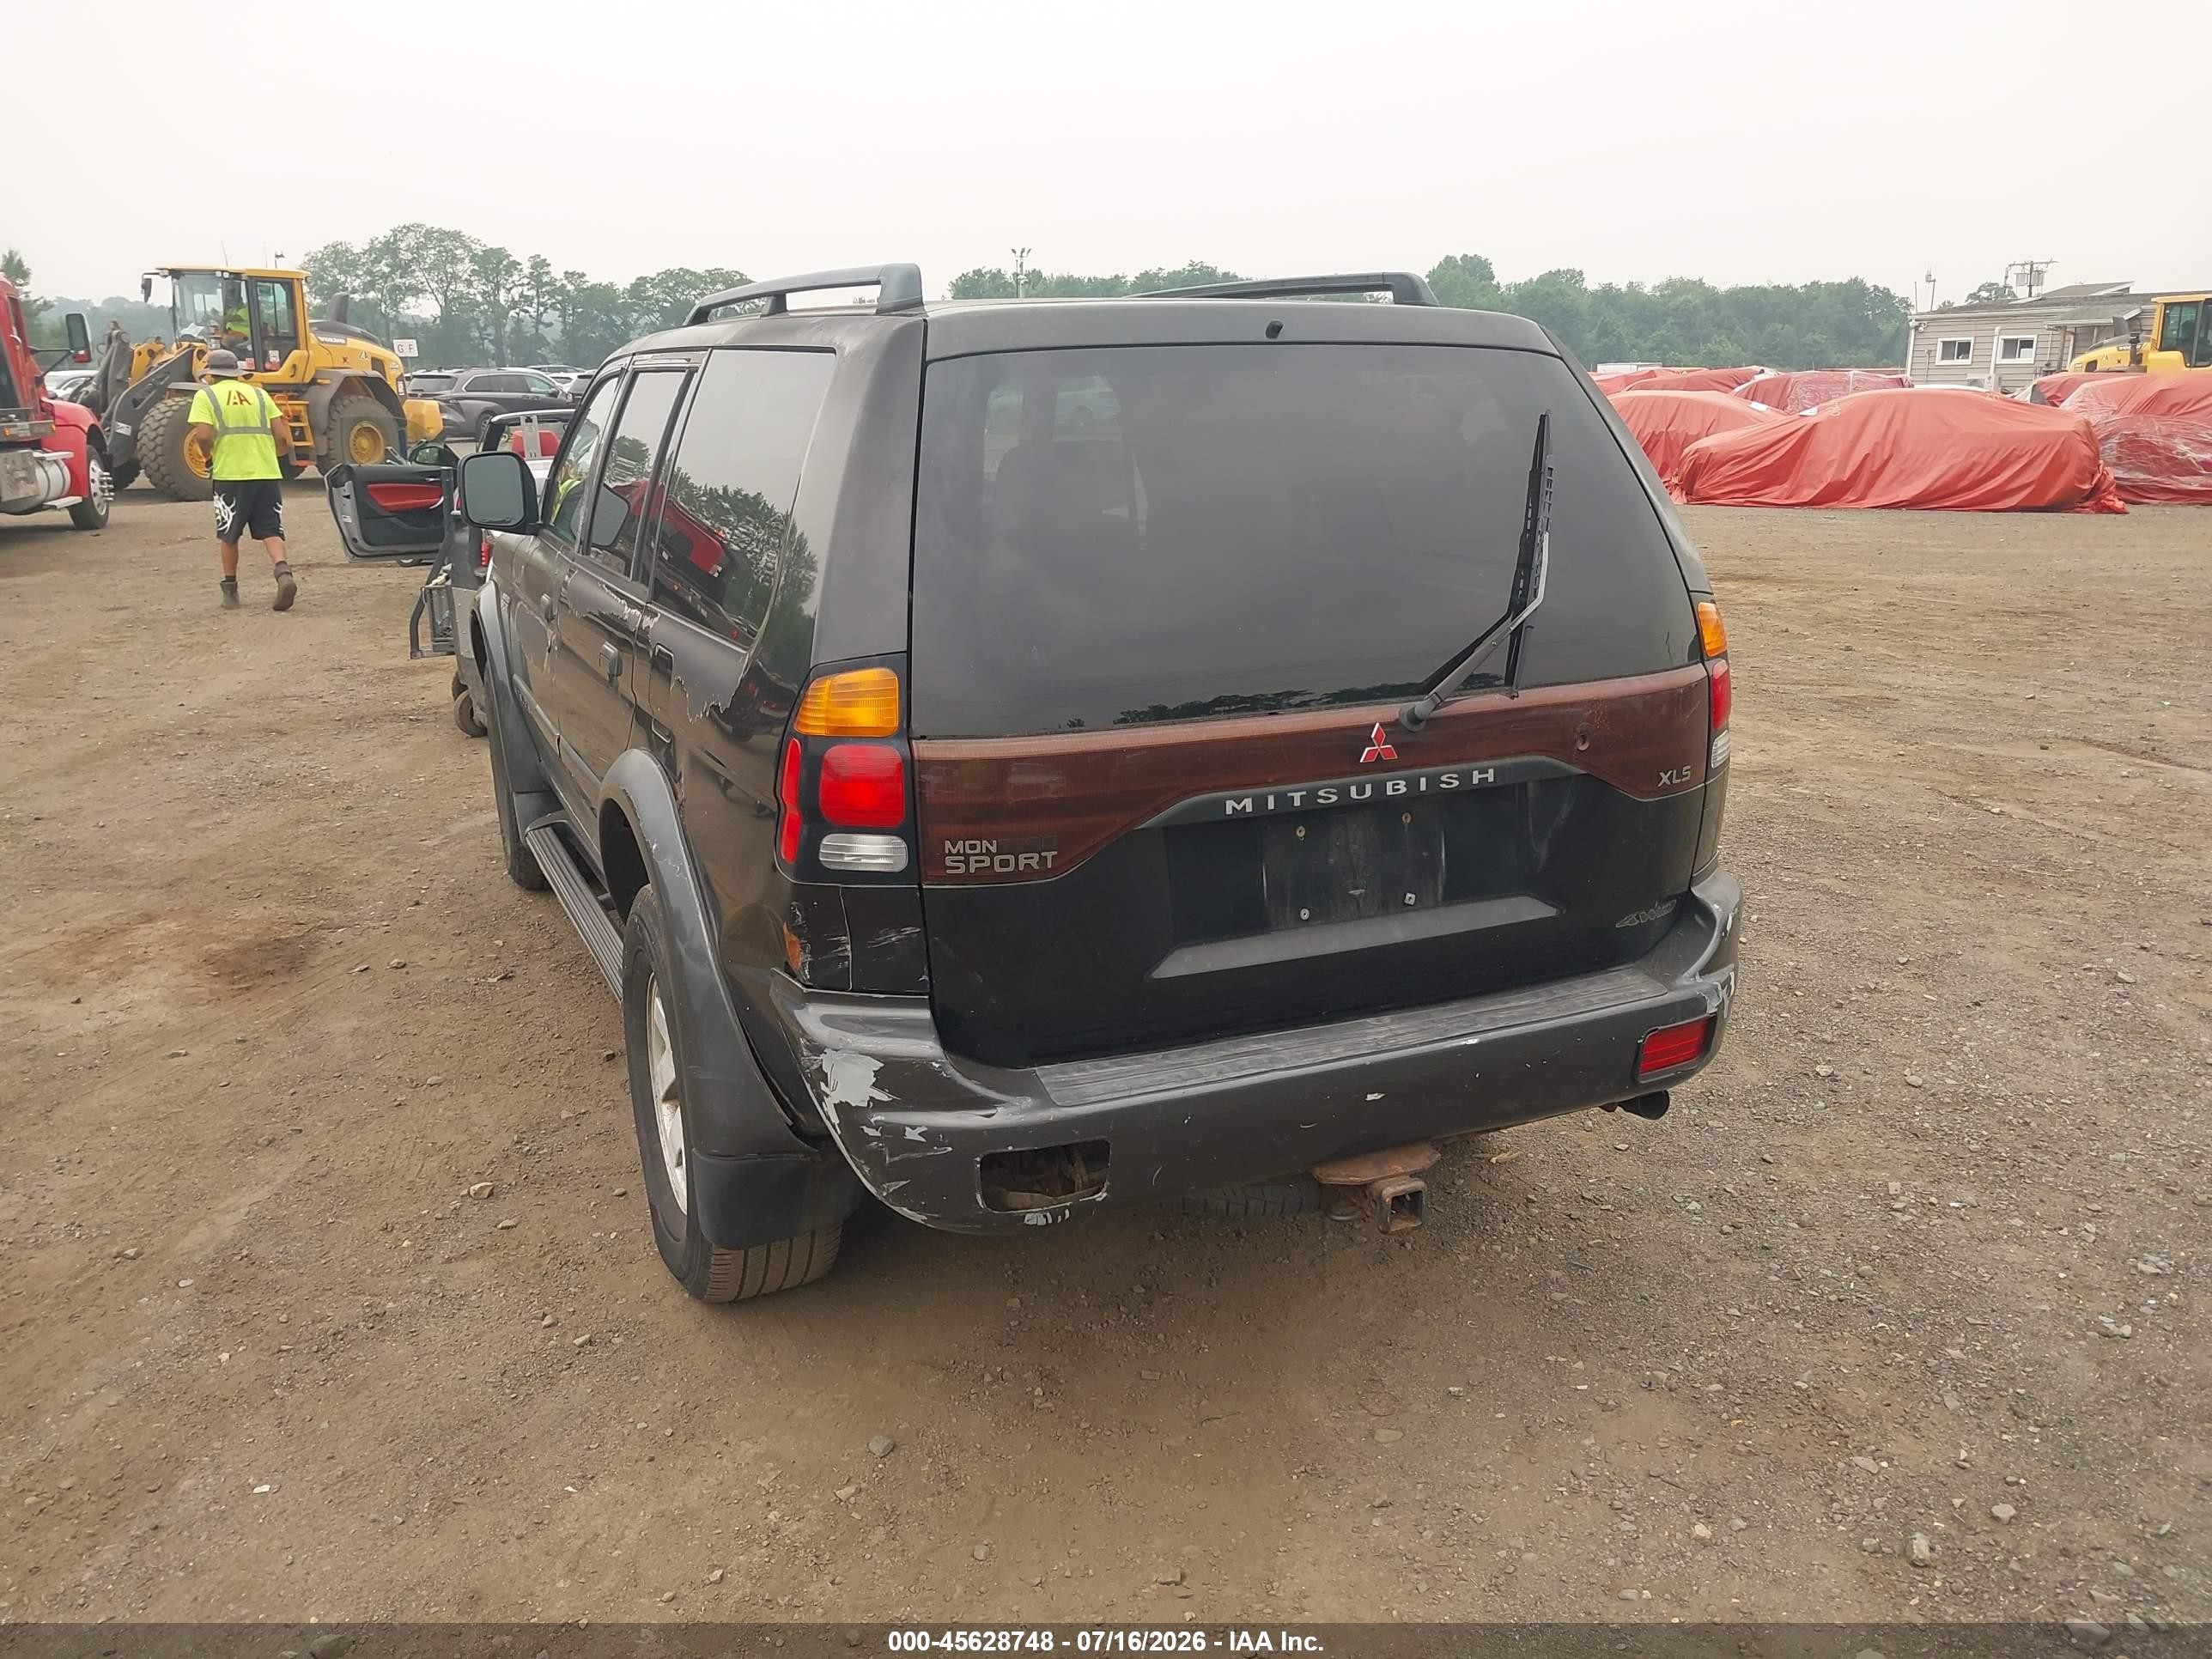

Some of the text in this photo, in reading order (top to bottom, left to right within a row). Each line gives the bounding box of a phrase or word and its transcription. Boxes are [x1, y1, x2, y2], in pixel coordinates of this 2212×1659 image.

[397, 343, 414, 354] G F
[1657, 765, 1692, 787] XLS
[1224, 768, 1495, 816] MITSUBISH
[945, 840, 997, 854] MON
[945, 851, 1059, 874] SPORT
